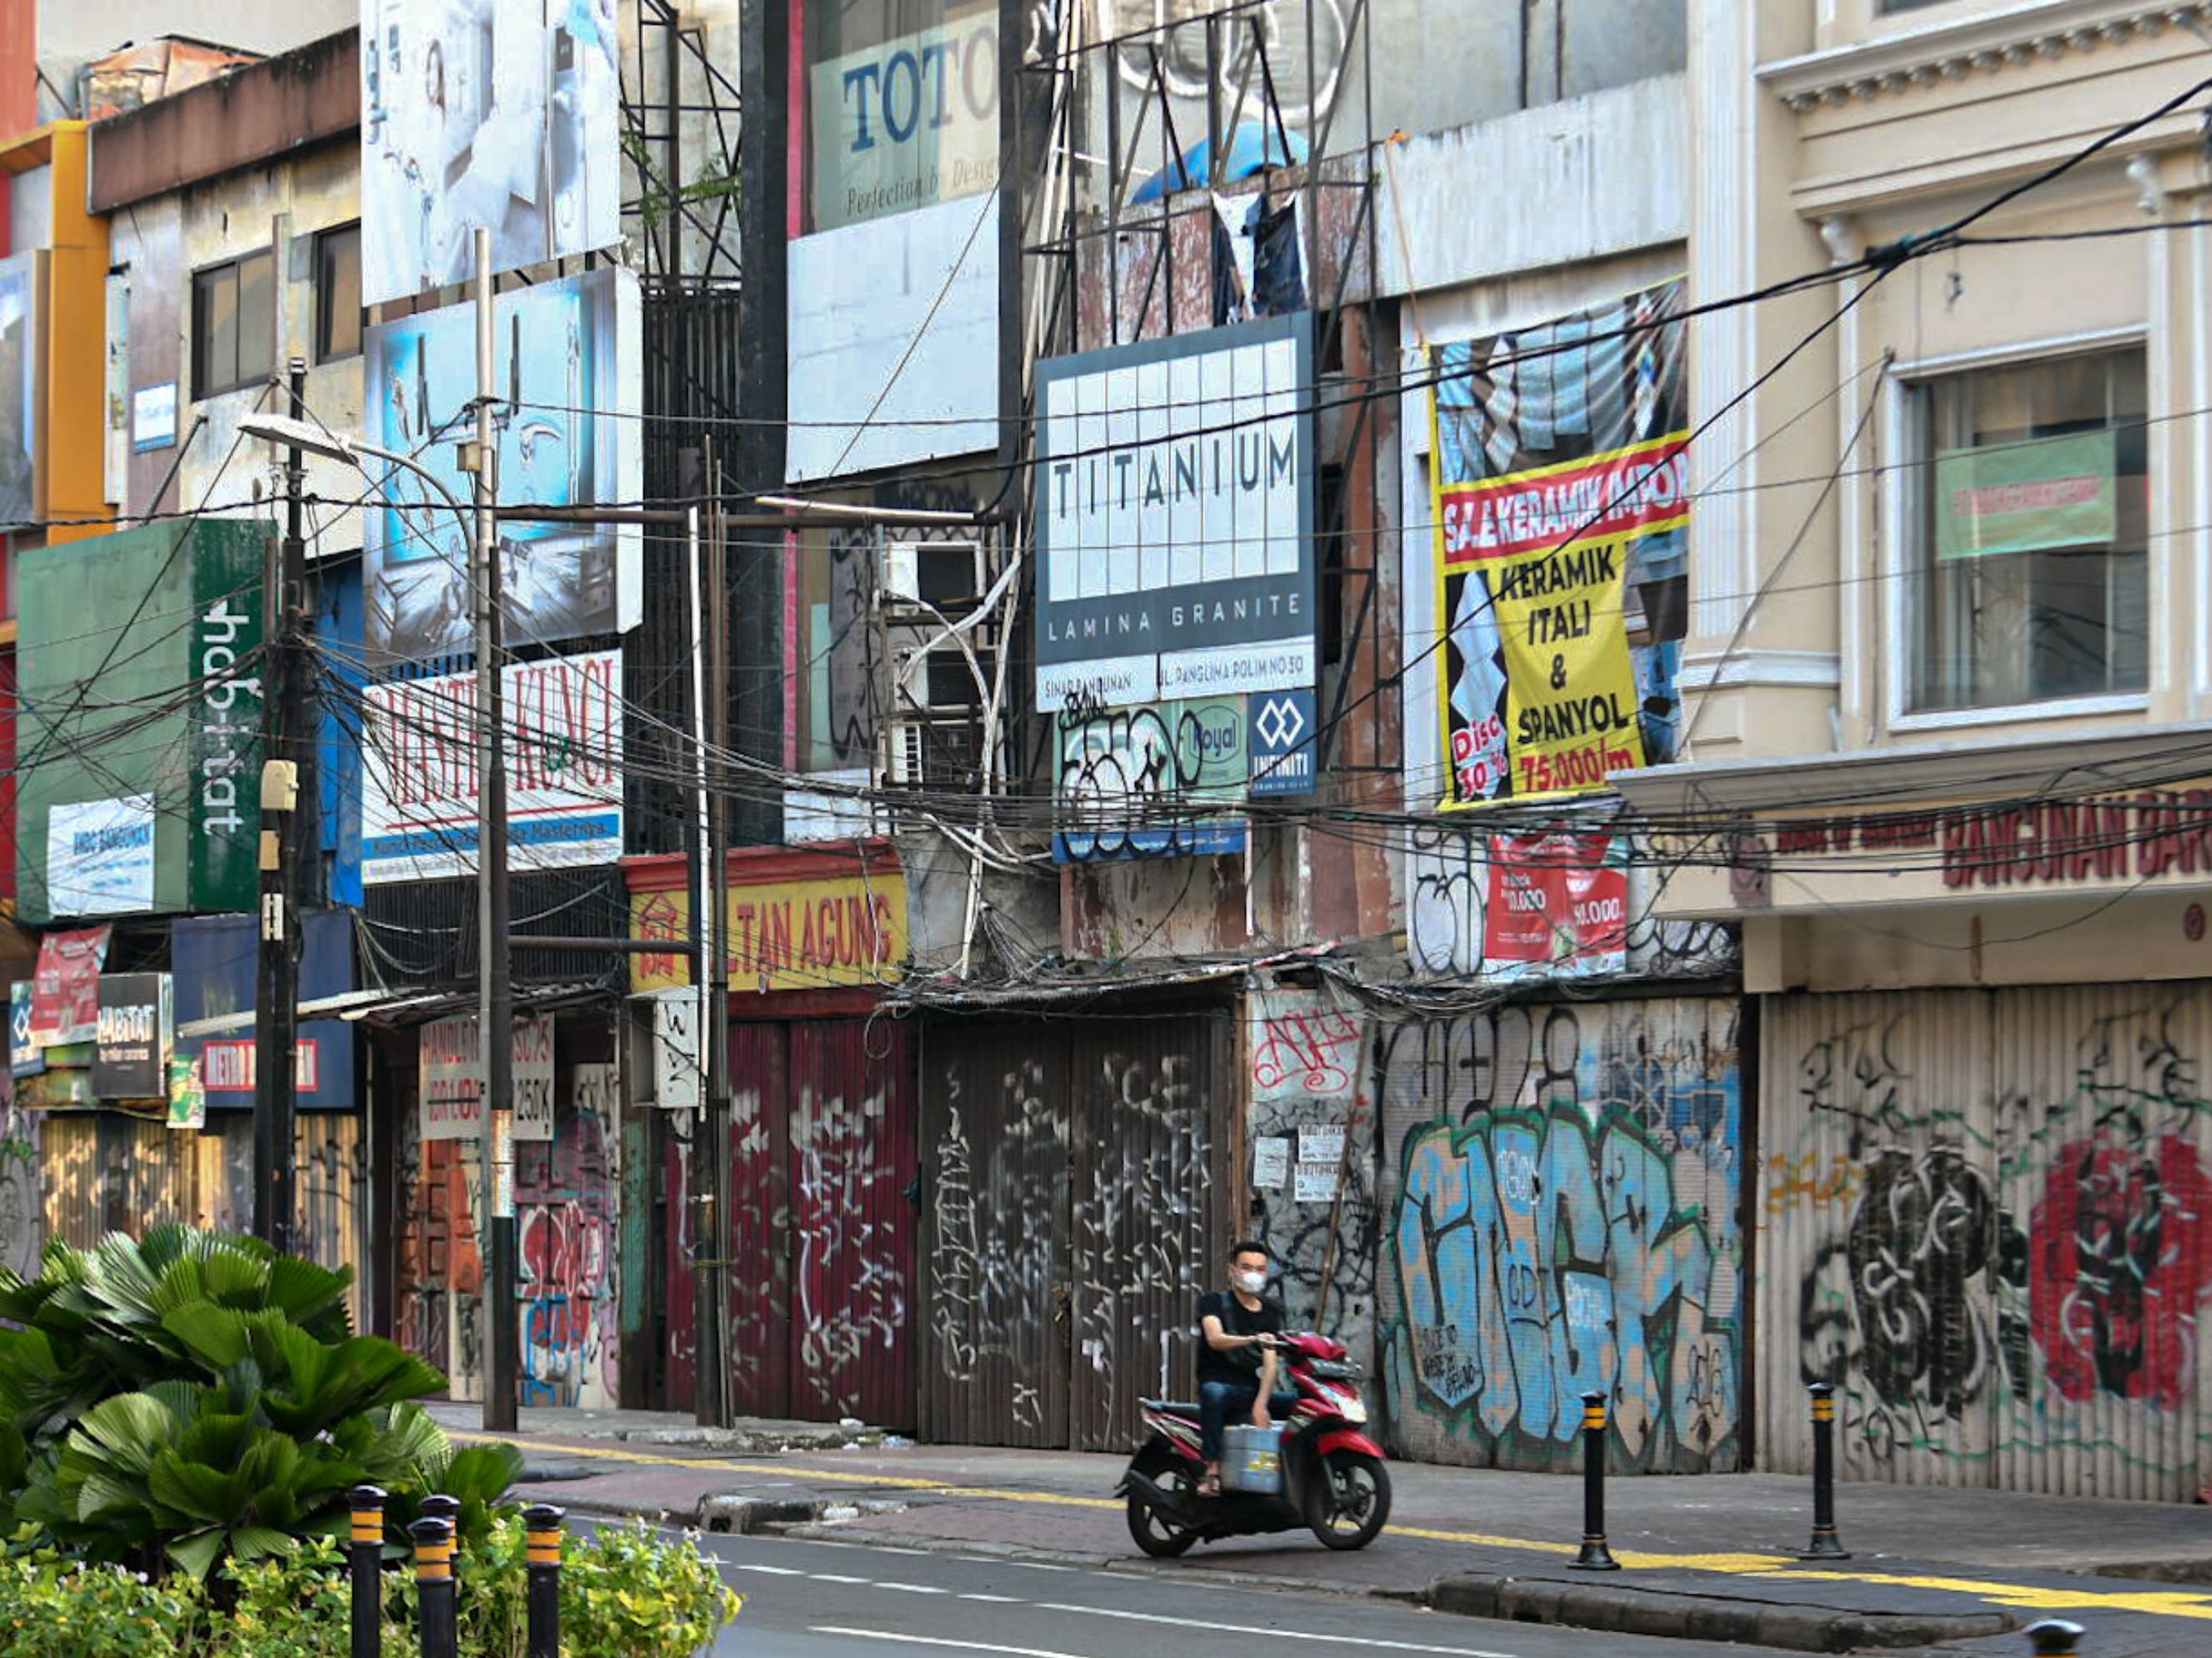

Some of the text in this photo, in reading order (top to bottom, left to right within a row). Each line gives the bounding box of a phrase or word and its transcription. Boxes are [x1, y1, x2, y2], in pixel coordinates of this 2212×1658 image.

[843, 26, 998, 152] TOTO
[1054, 428, 1295, 519] TITANIUM
[1499, 545, 1616, 602] KERAMIK
[1048, 593, 1300, 642] LAMINA GRANITE
[1529, 600, 1592, 646] ITALI
[1550, 654, 1567, 691] &
[514, 659, 614, 793] KUNCI
[1454, 714, 1501, 763] Disc
[1517, 693, 1629, 744] SPANYOL
[1253, 752, 1309, 778] INFINITI
[1943, 794, 2128, 888] BANGUNAN
[737, 894, 891, 973] TAN AGUNG
